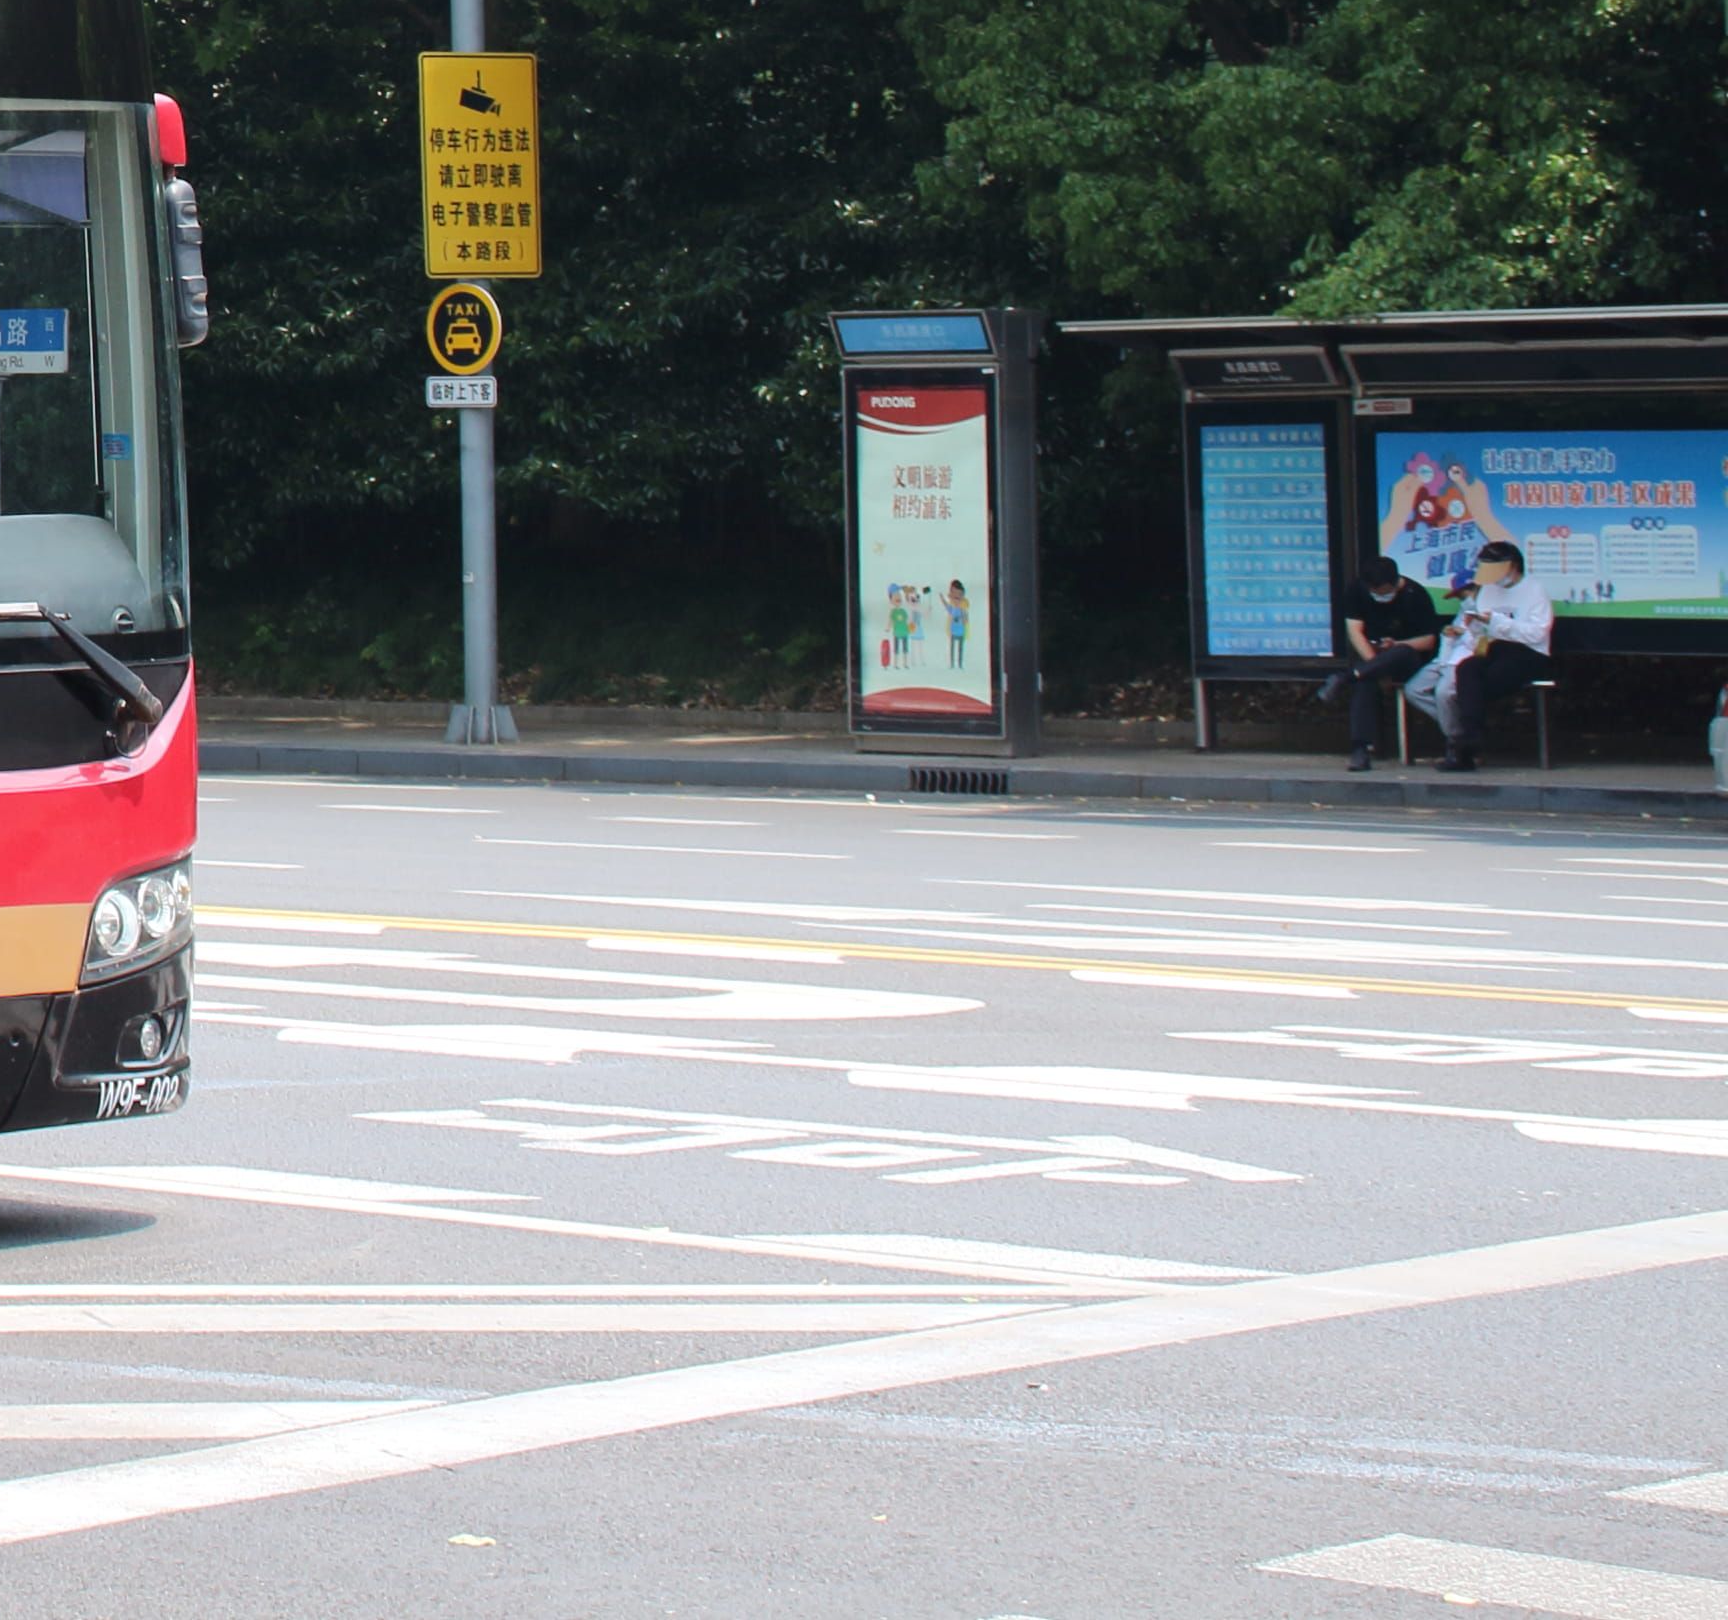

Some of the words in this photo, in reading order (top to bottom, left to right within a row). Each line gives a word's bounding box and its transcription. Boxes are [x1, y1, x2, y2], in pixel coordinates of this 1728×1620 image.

[429, 128, 530, 153] 停车行为违法
[439, 164, 523, 189] 请立即驶离
[431, 201, 532, 228] 电子警察监管
[446, 303, 480, 317] TAXI
[871, 396, 916, 408] PUDONG
[893, 465, 952, 489] 文明旅游
[892, 494, 952, 520] 相约浦东
[1405, 521, 1477, 554] 上海市民
